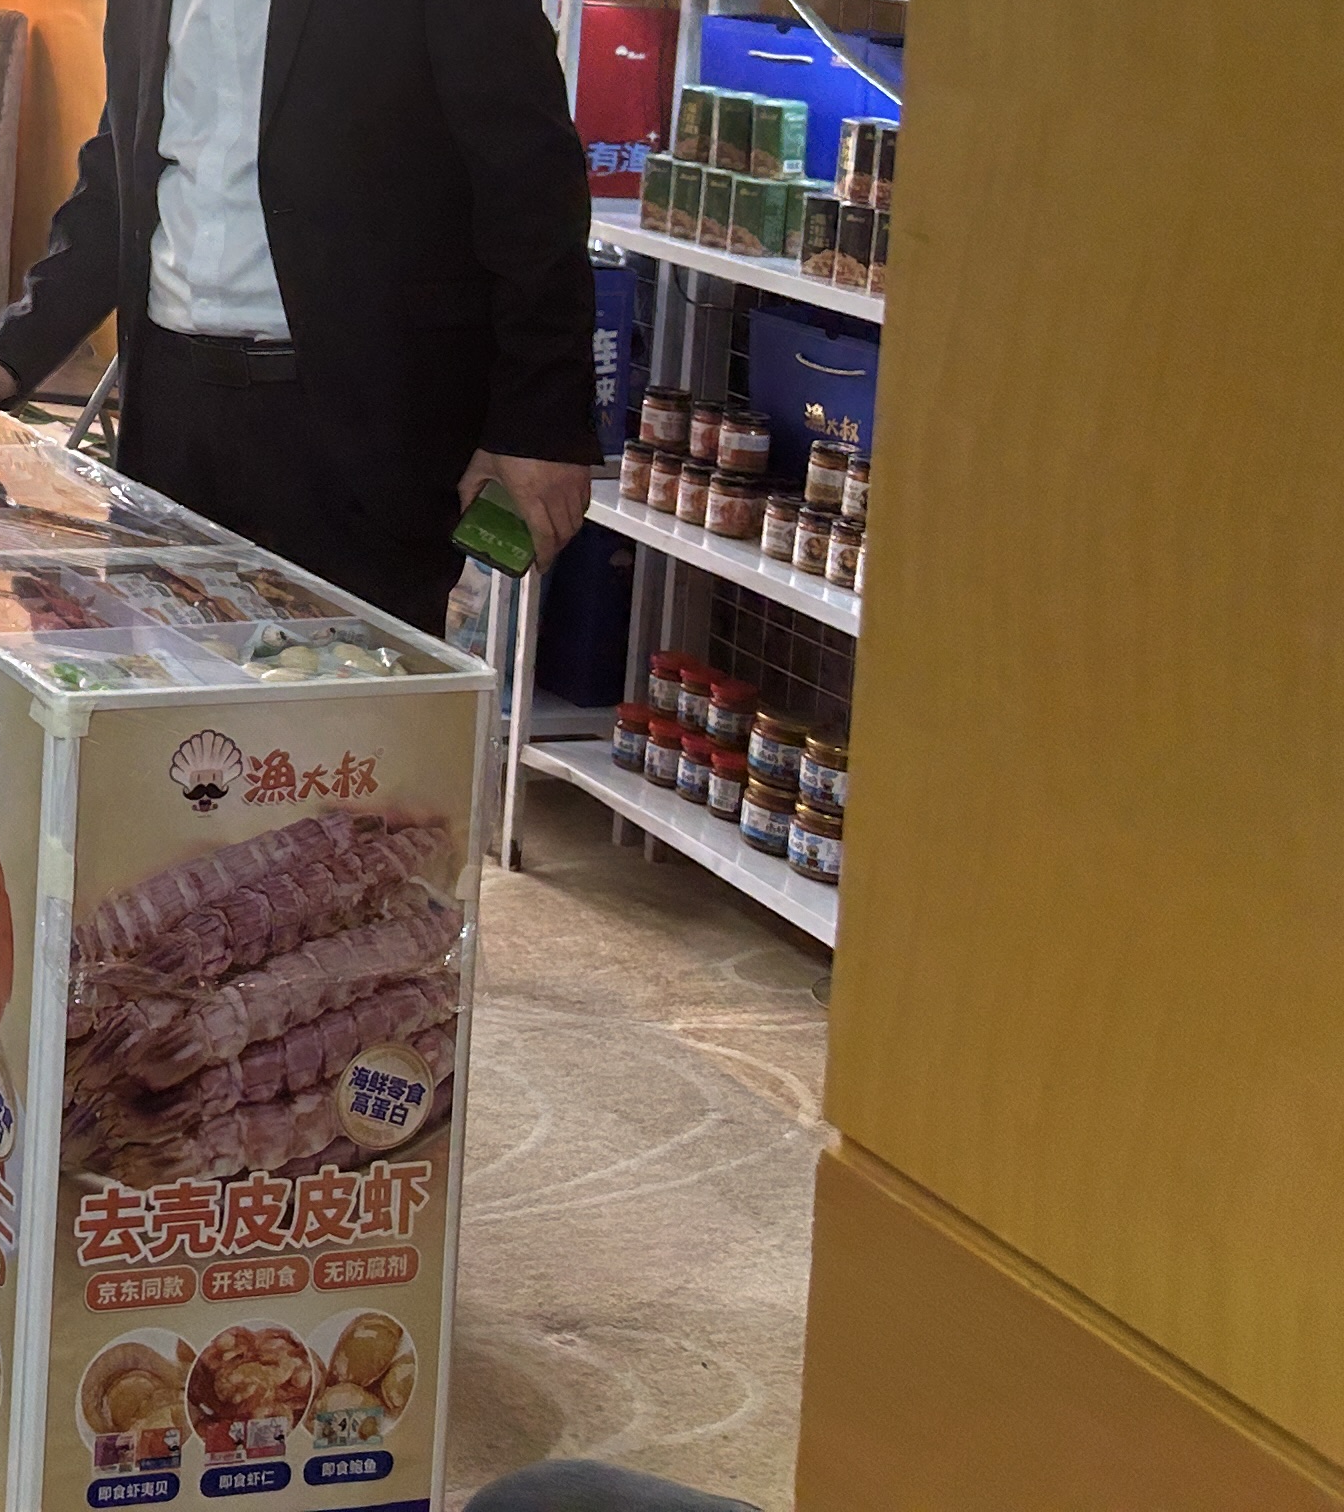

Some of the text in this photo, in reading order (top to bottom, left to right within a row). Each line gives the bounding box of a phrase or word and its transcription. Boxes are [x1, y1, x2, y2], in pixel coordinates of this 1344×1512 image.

[347, 1065, 427, 1106] 海鲜零食
[349, 1090, 410, 1128] 高蛋白
[75, 1160, 432, 1267] 去壳皮皮虾
[211, 1262, 296, 1295] 开袋即食
[323, 1254, 409, 1284] 无防腐剂
[96, 1270, 184, 1304] 京东同款
[218, 1470, 275, 1490] 即食虾仁
